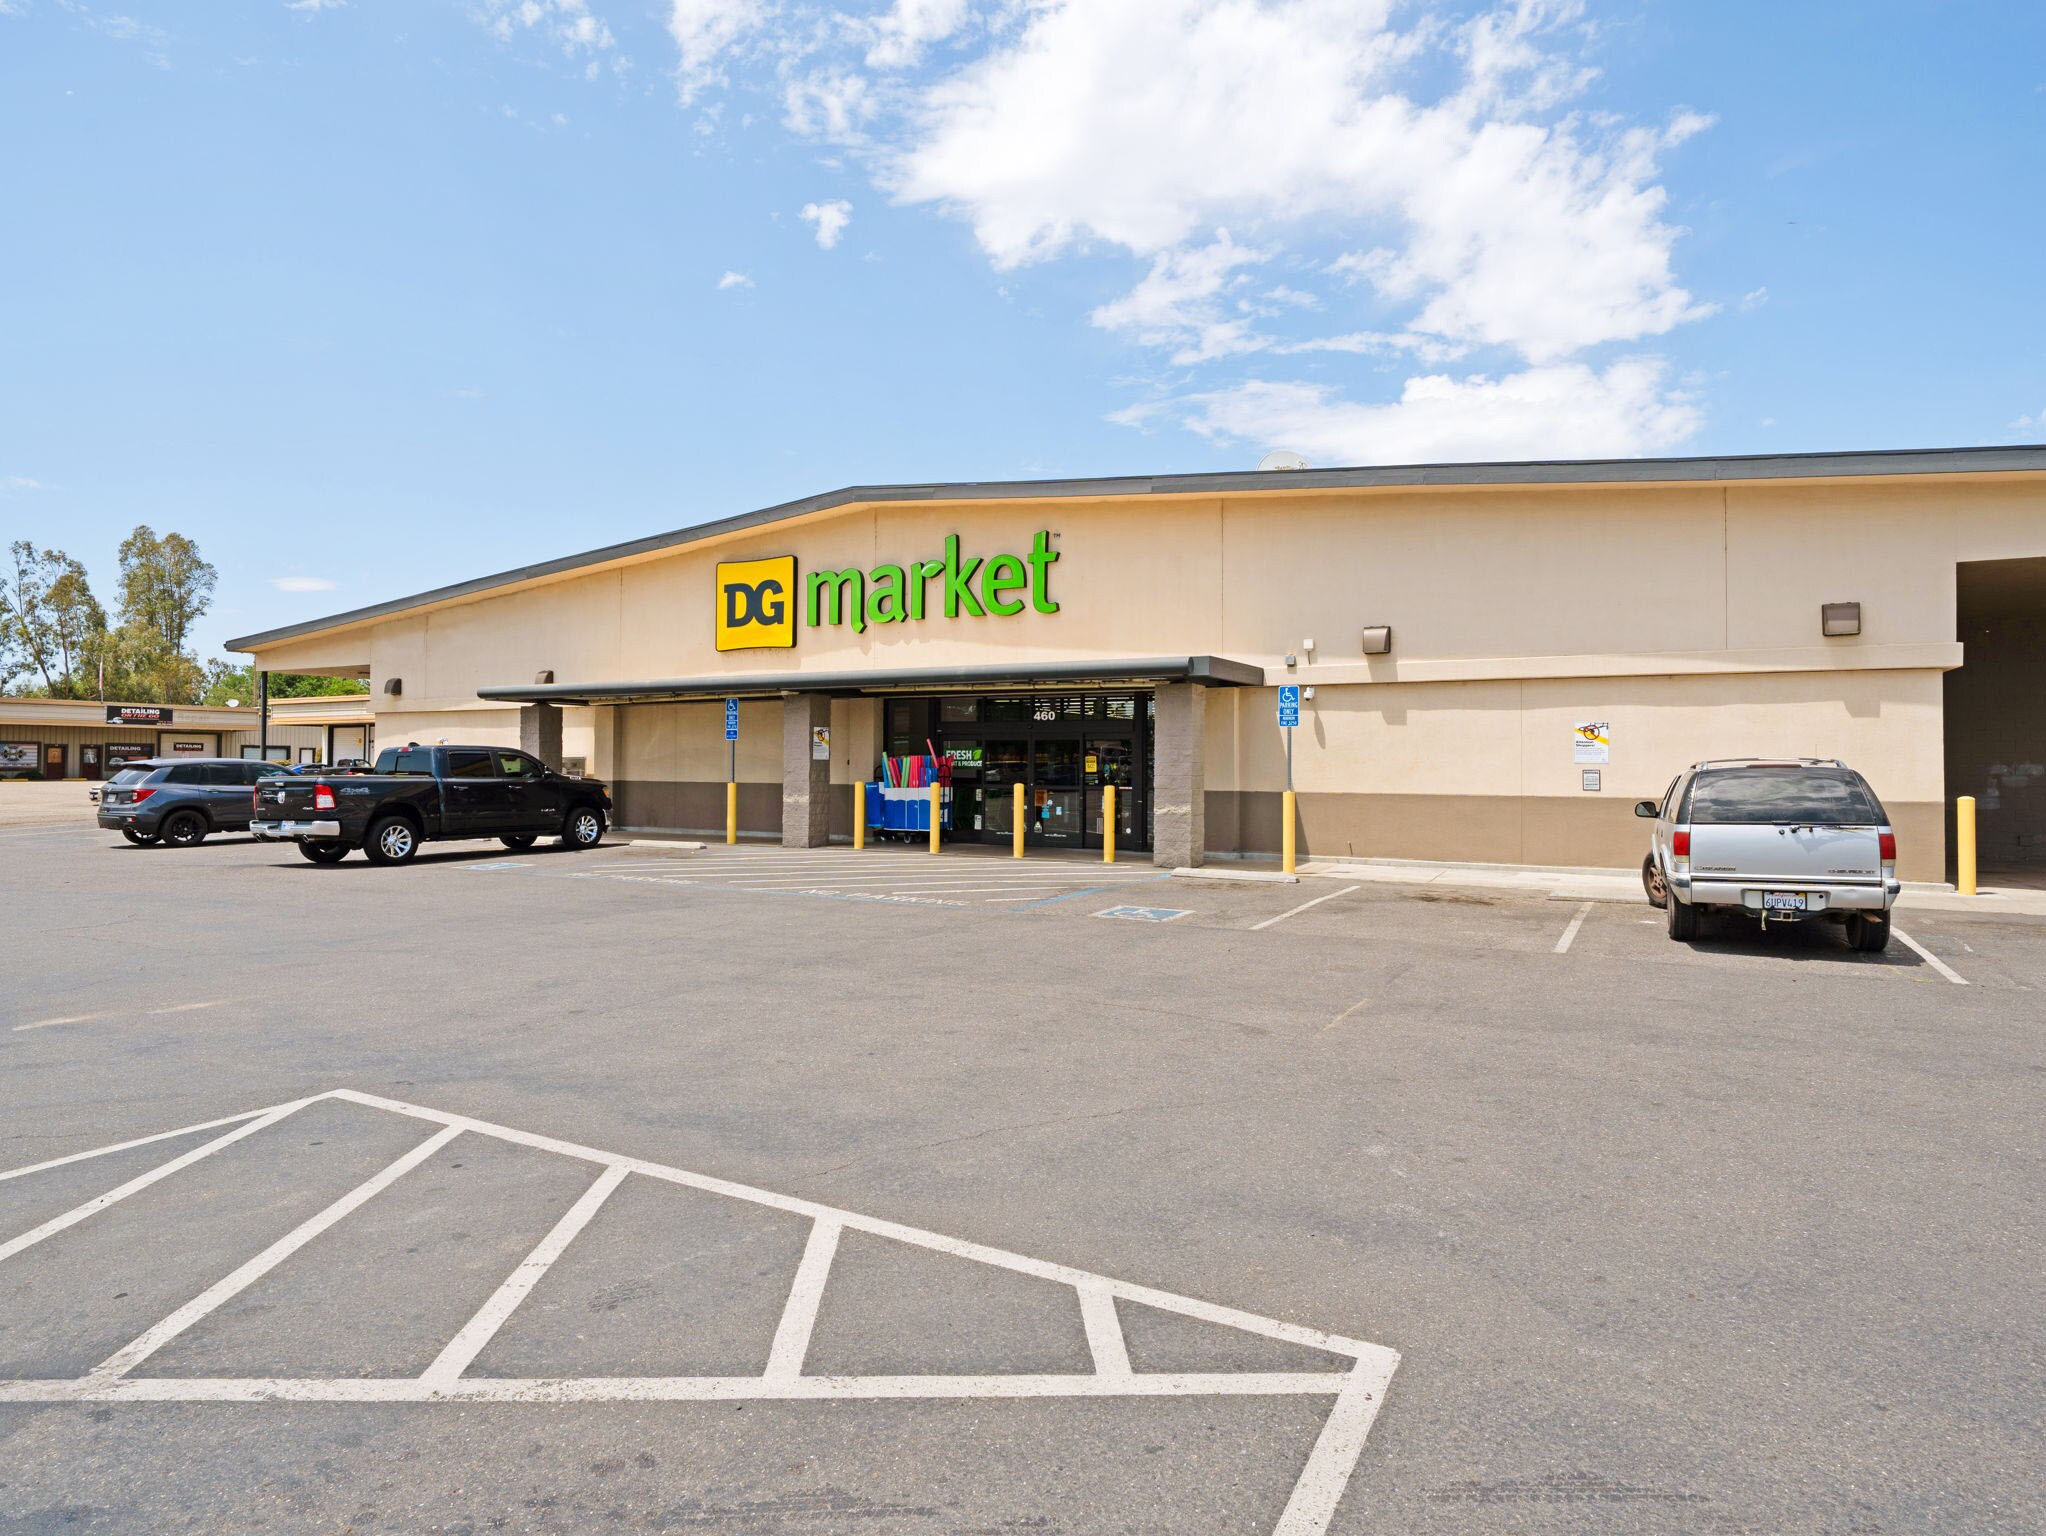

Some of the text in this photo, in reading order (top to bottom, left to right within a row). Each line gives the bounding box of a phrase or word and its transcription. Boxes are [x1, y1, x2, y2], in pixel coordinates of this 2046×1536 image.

[723, 530, 1060, 634] DG market
[1033, 711, 1055, 720] 460
[946, 750, 972, 760] FRESH
[1765, 898, 1804, 908] 6UPV419
